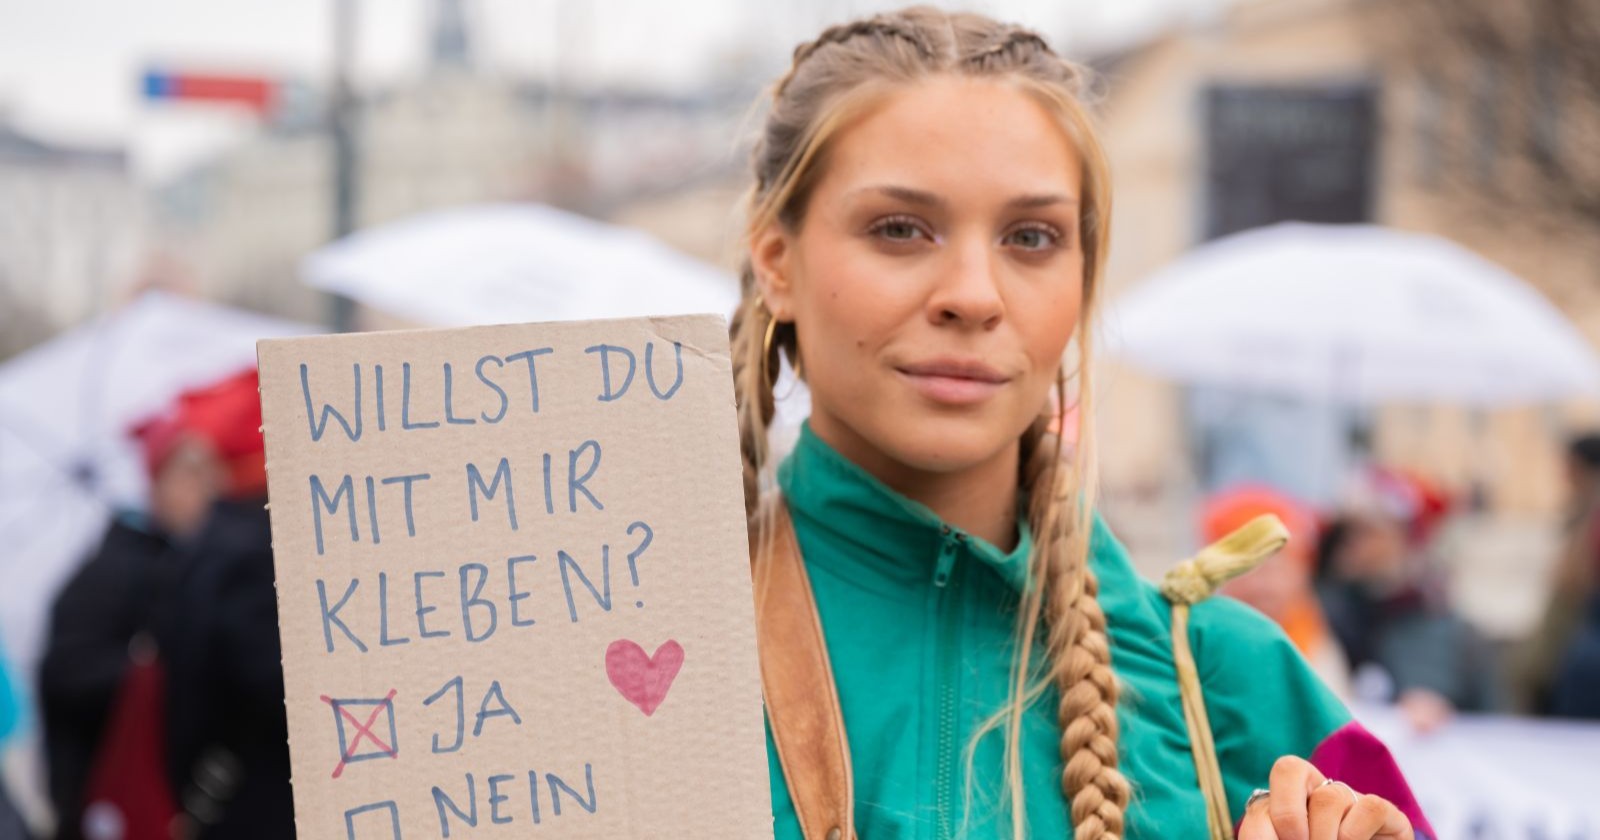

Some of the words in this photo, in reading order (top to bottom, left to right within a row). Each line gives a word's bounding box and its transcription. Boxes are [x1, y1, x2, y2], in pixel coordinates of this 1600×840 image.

[300, 347, 553, 441] WILLST
[585, 342, 684, 401] DU
[309, 473, 431, 555] MIT
[466, 440, 604, 530] MIR
[316, 521, 653, 652] KLEBEN?
[423, 676, 521, 754] JA
[432, 763, 597, 838] NEIN
